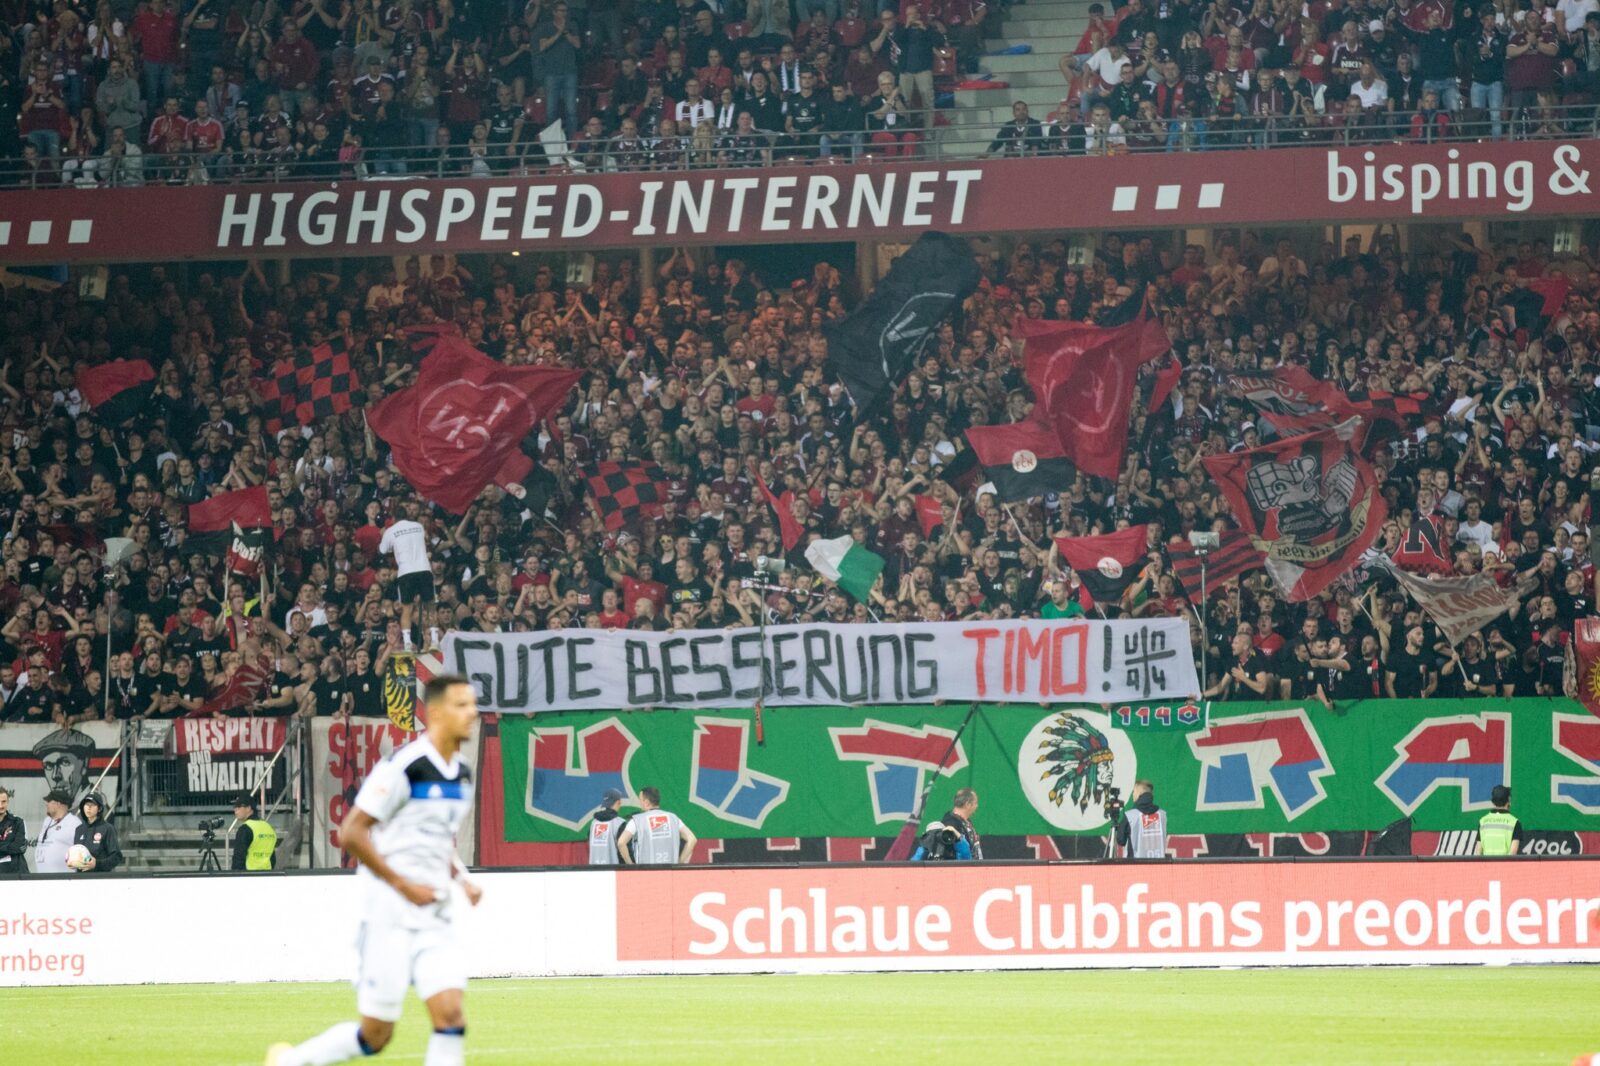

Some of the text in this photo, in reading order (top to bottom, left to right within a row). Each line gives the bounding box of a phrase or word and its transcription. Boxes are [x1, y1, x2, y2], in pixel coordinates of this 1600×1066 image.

[1327, 145, 1592, 213] bisping &
[217, 169, 983, 247] HIGHSPEED-INTERNET
[1403, 516, 1446, 562] N
[453, 636, 602, 708] GUTE
[624, 630, 939, 705] BESSERUNG
[184, 718, 277, 752] RESPEKT
[189, 749, 212, 765] UND
[187, 755, 275, 793] RIVALITÄT
[688, 887, 952, 956] Schlaue
[972, 883, 1264, 953] Clubfans
